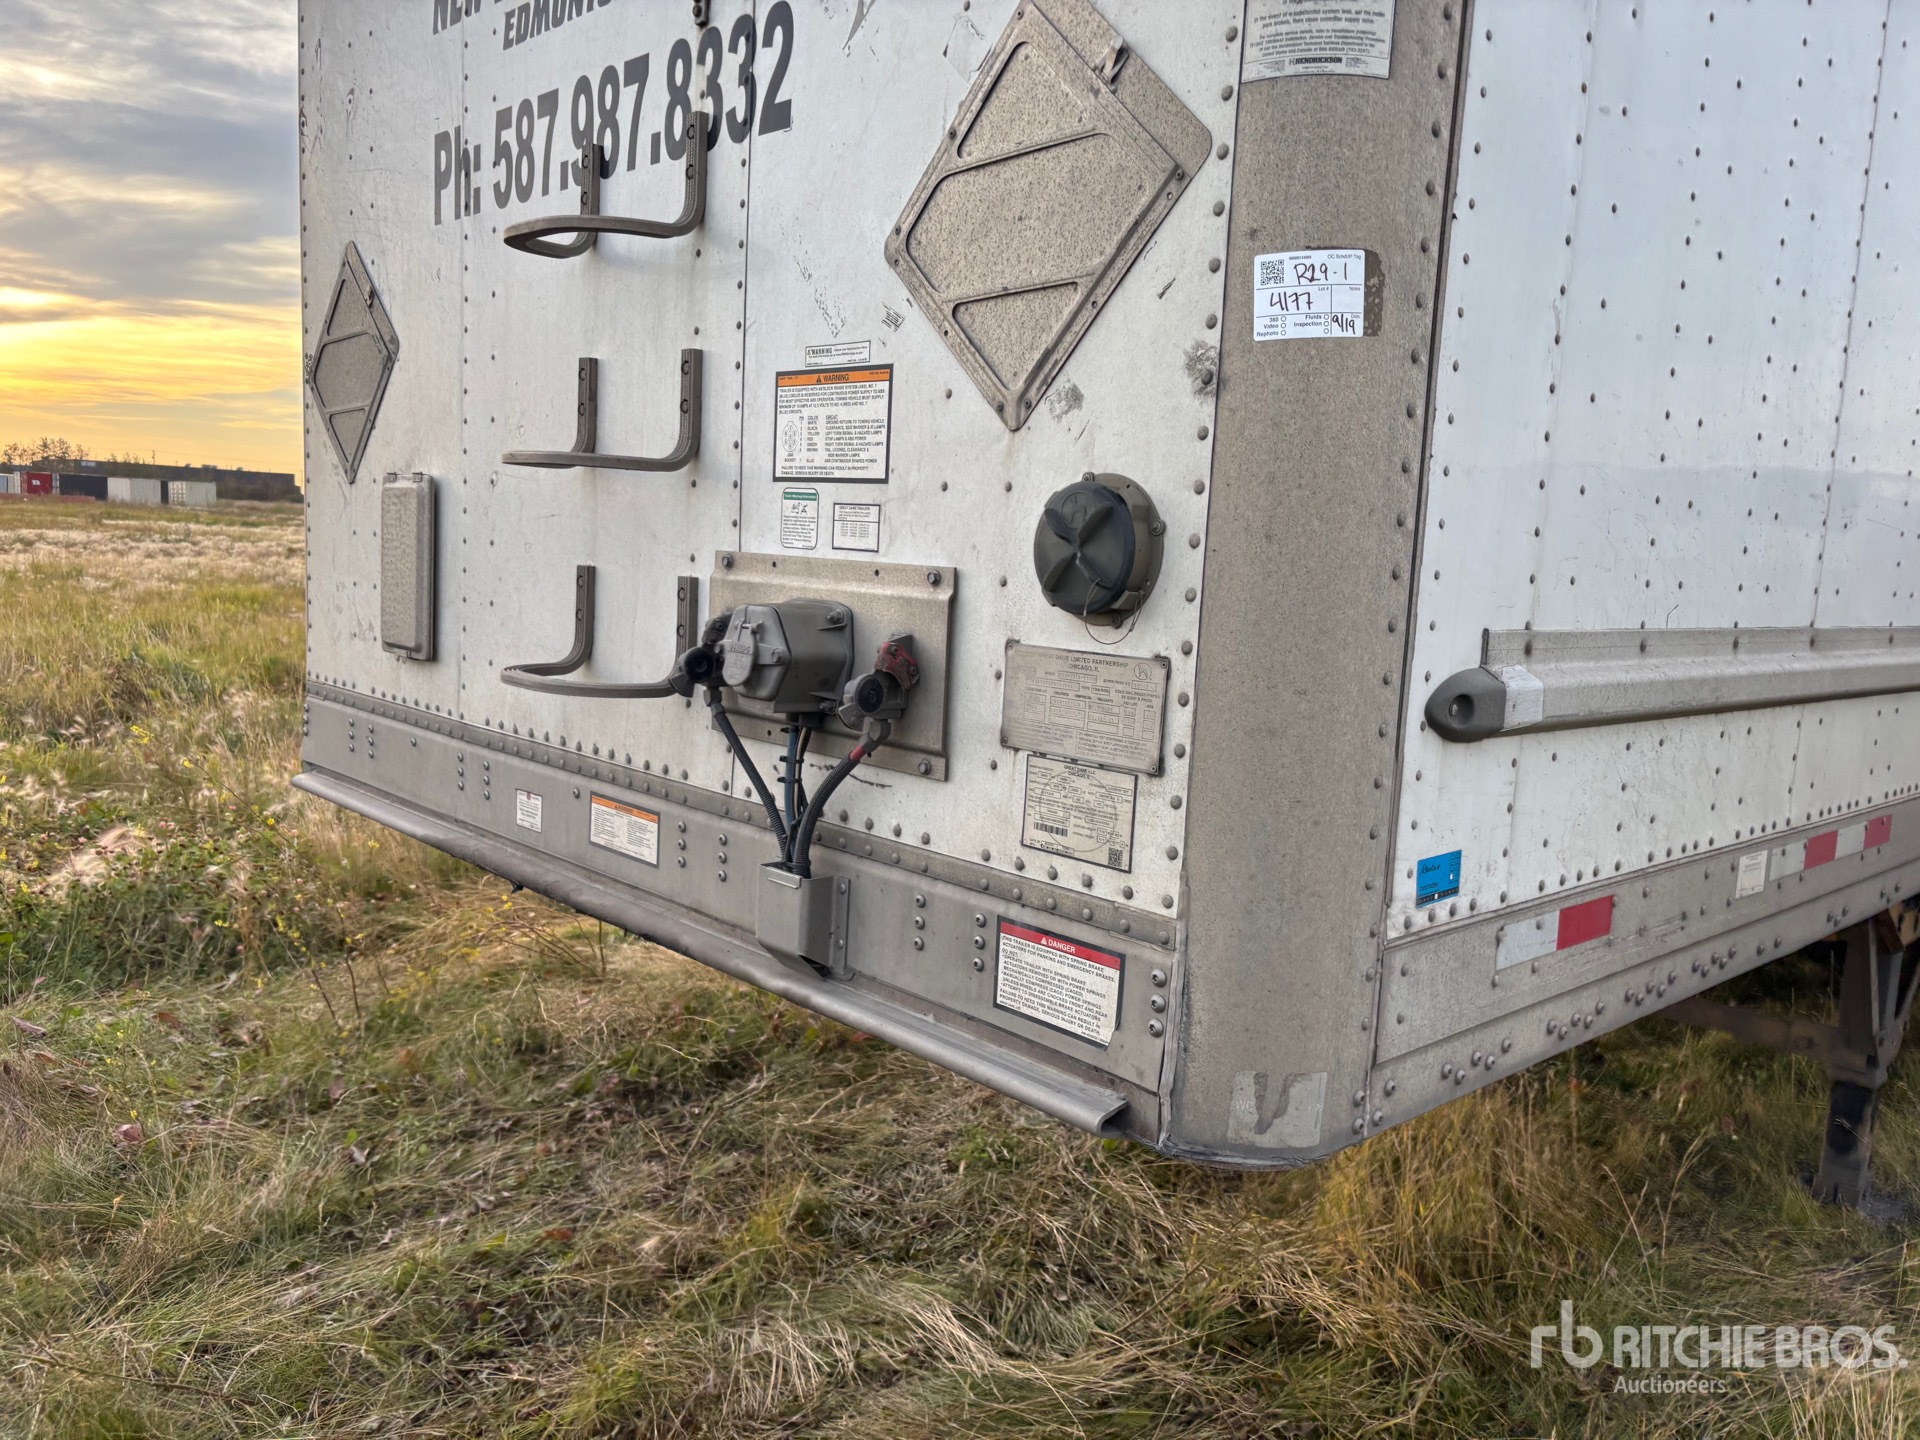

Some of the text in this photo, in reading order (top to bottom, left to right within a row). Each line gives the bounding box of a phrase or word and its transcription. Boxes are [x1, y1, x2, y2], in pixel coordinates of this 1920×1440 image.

[434, 0, 794, 226] Ph: 587.987.8332
[1270, 291, 1313, 312] 4177
[823, 374, 849, 382] WARNING
[1069, 664, 1093, 672] CHICAGO,
[1092, 659, 1128, 667] PARTNERSHIP
[1048, 938, 1076, 954] DANGER
